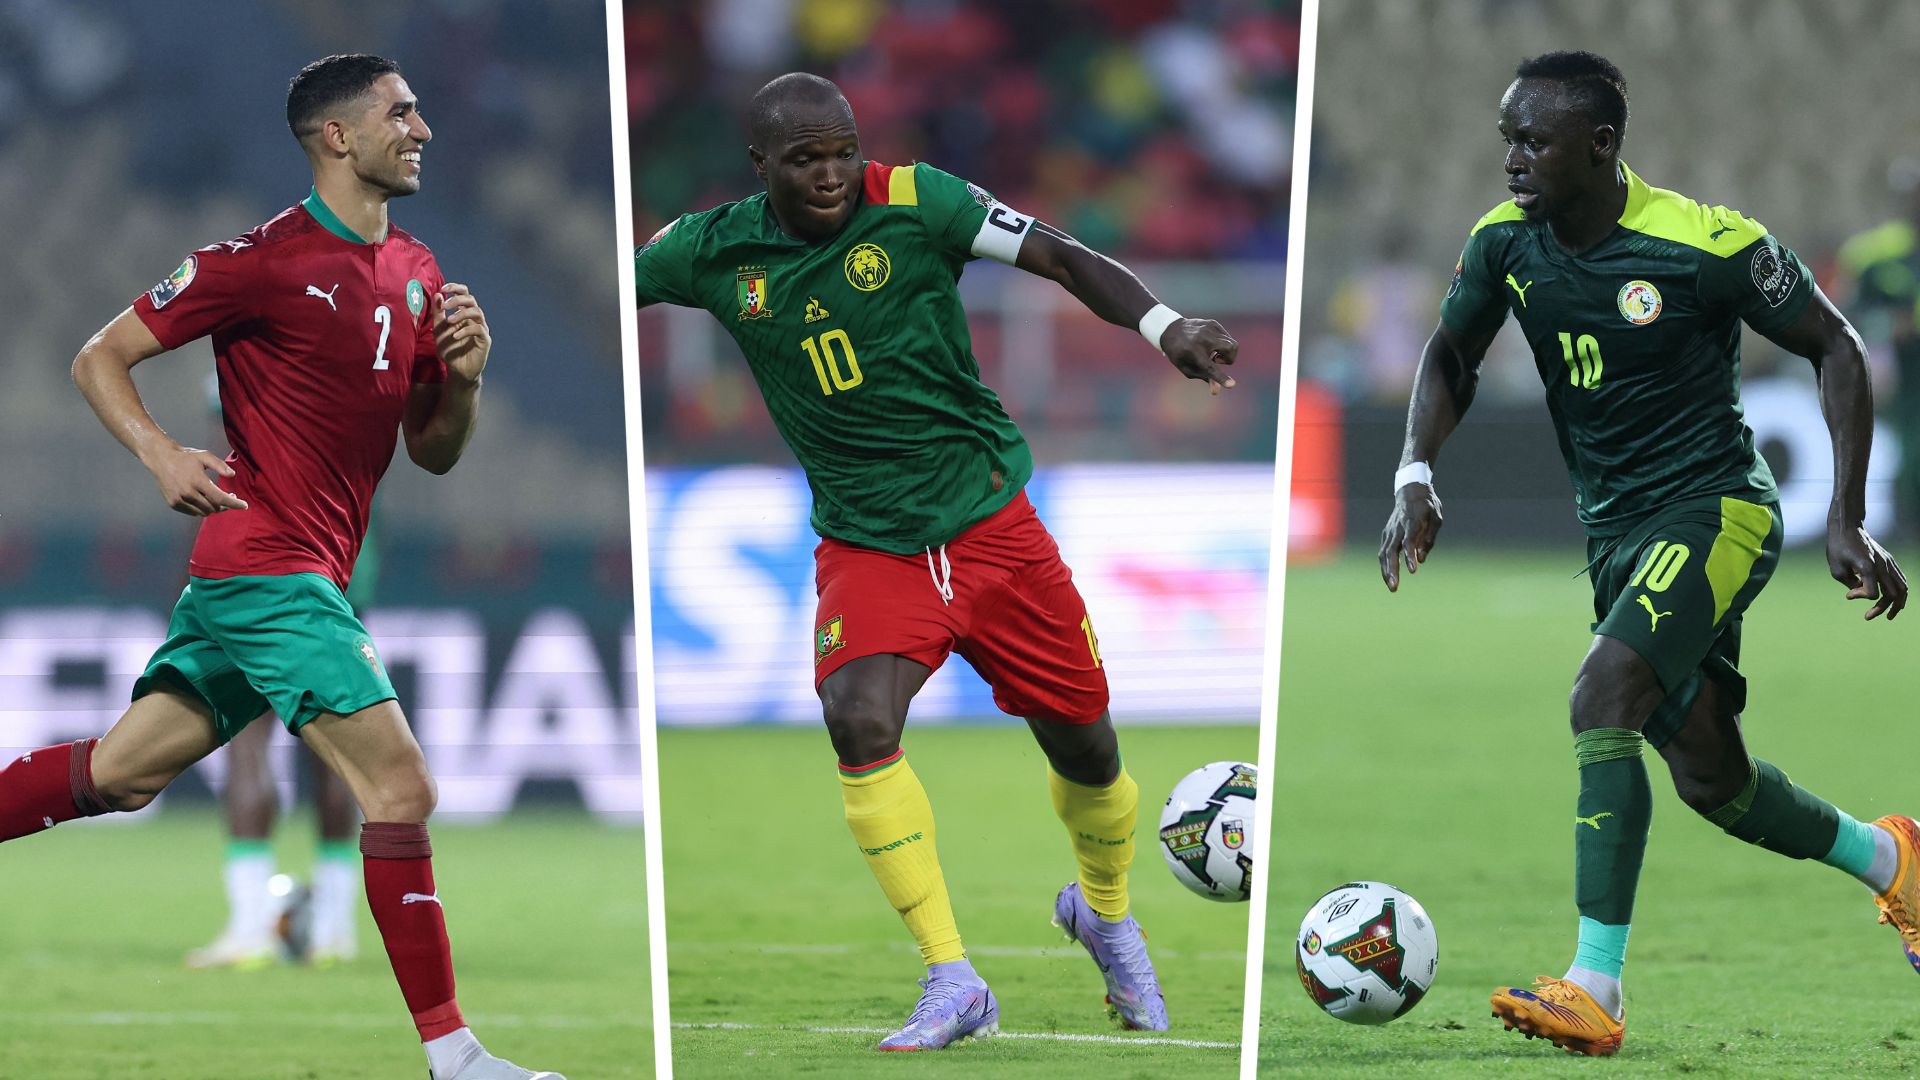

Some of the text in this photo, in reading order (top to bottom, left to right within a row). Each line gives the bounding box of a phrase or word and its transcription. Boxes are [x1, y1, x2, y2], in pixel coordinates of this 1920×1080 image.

[989, 208, 1027, 234] C
[373, 305, 392, 370] 2
[800, 328, 863, 395] 10
[1558, 332, 1603, 390] 10
[1631, 541, 1690, 592] 10
[1080, 614, 1100, 668] 1
